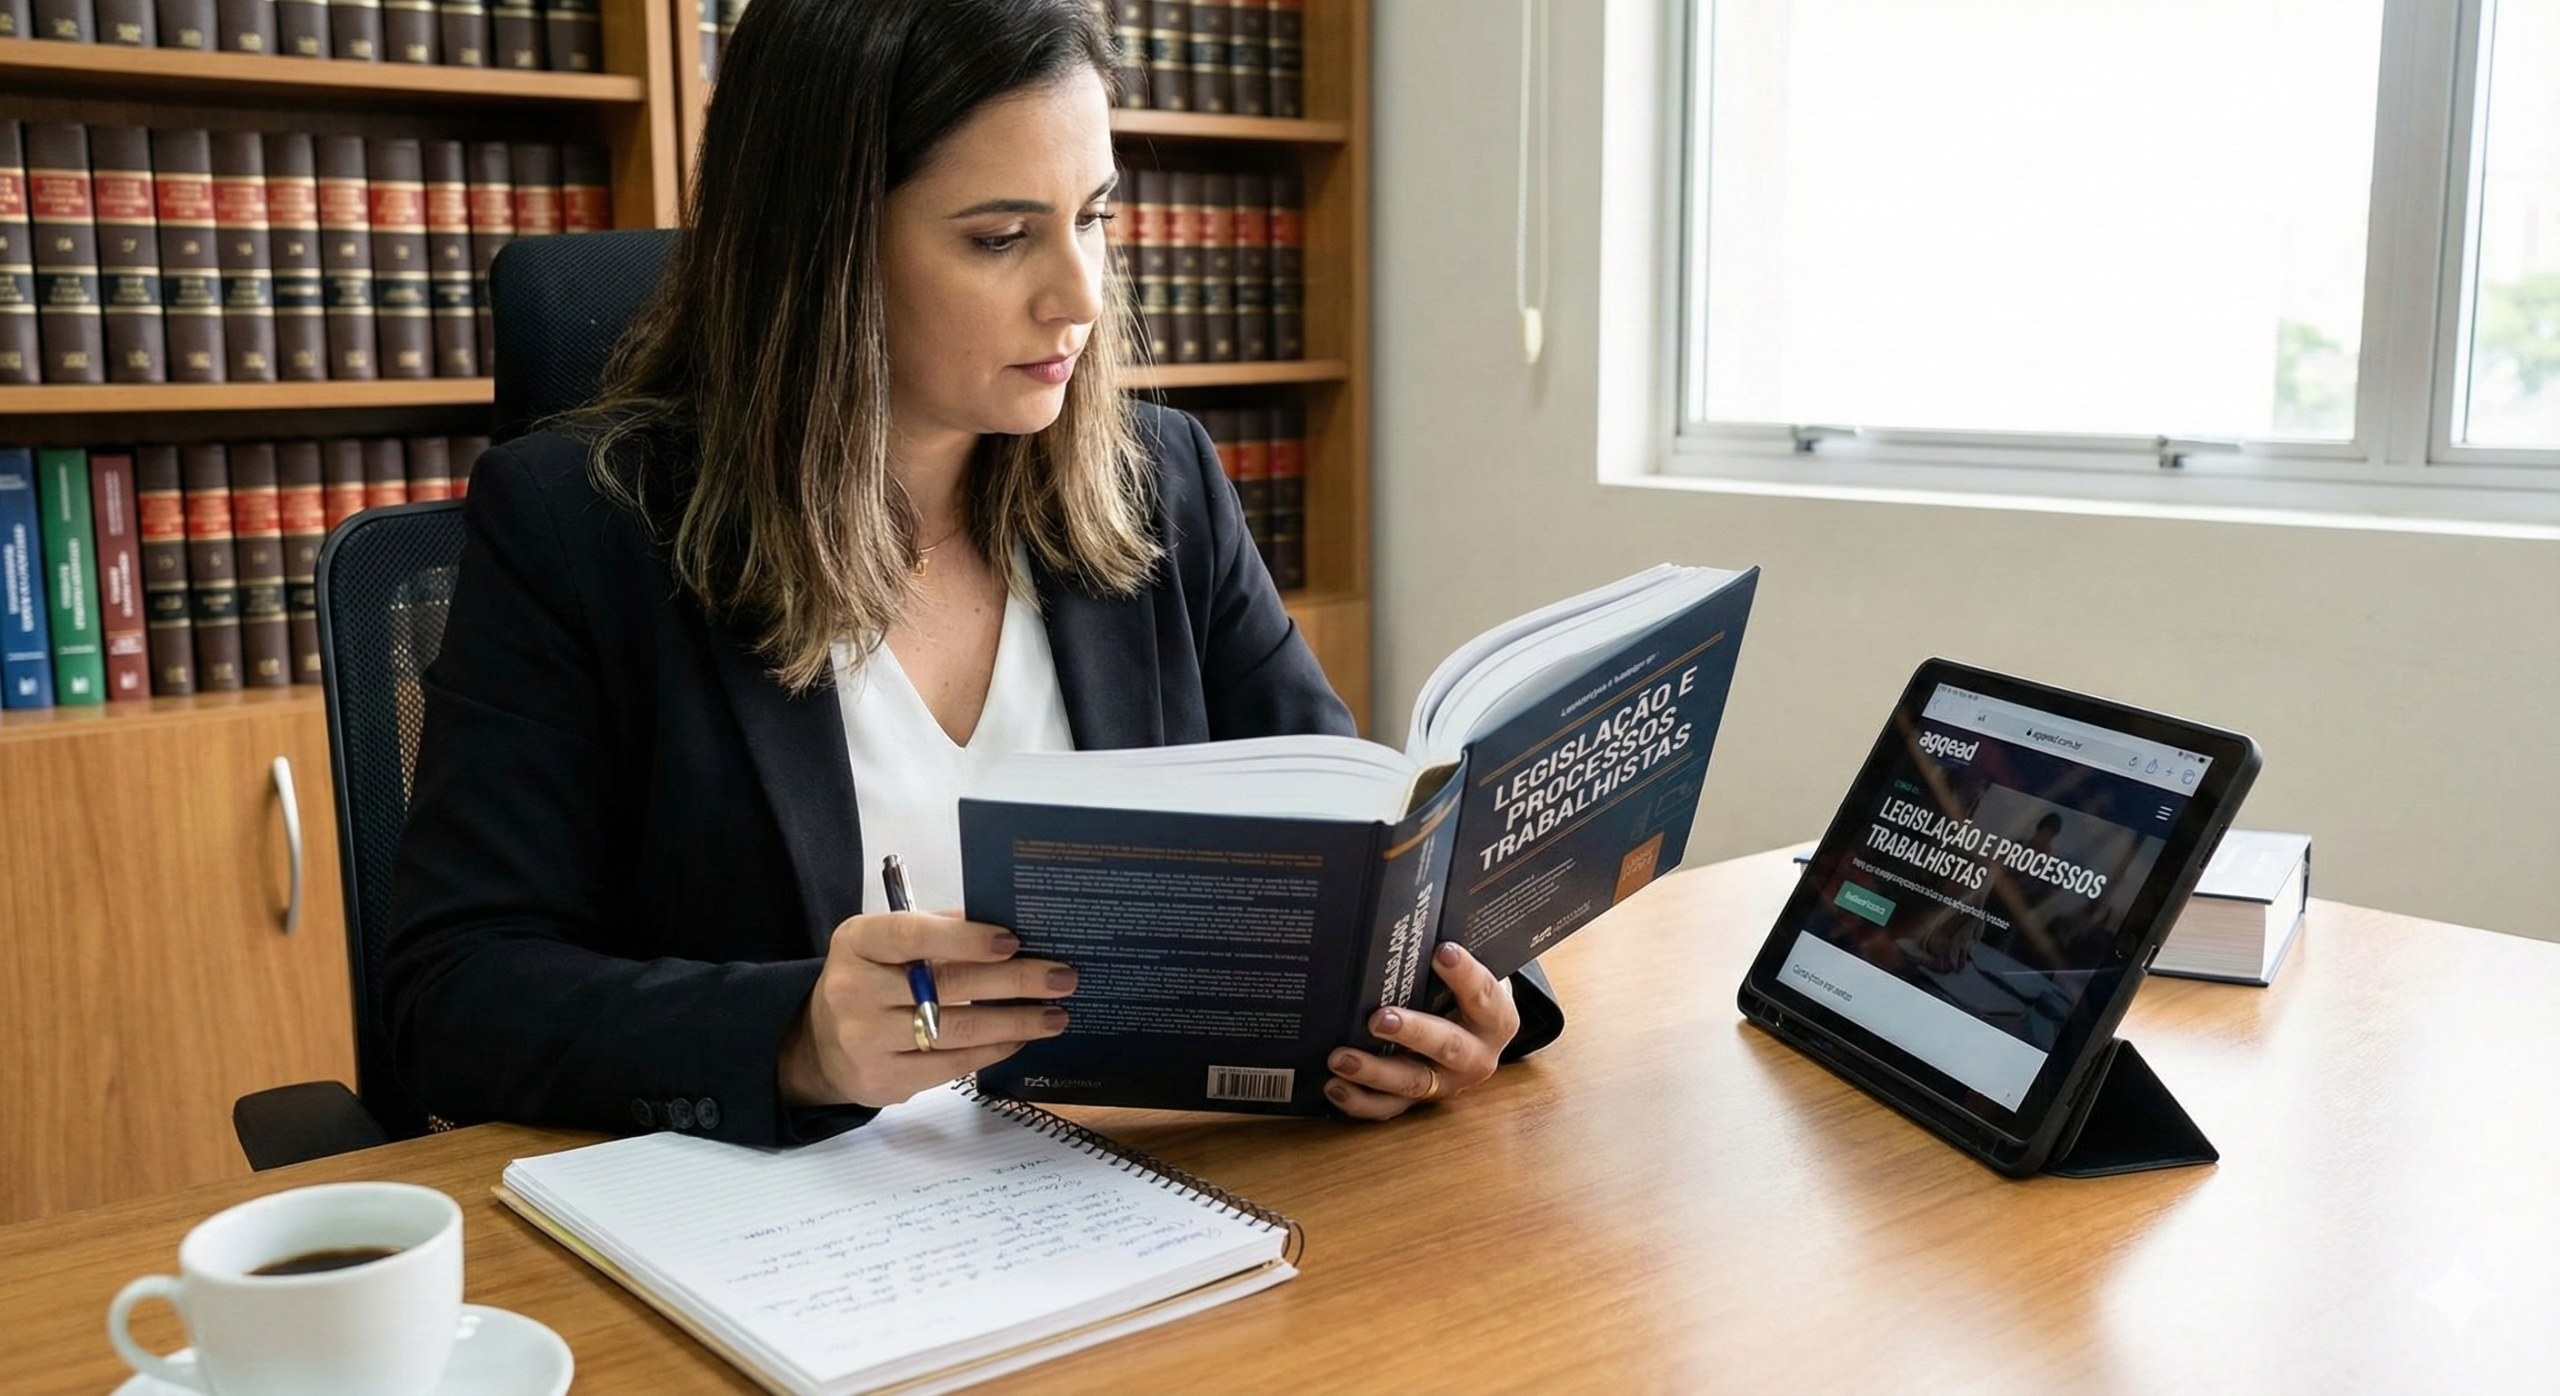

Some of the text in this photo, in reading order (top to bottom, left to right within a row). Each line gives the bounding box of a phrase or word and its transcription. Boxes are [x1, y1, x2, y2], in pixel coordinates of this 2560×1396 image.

[1480, 722, 1692, 871] TRABALHISTAS
[1494, 683, 1671, 812] LEGISLAÇÃO
[1678, 666, 1698, 697] E
[1506, 706, 1677, 831] PROCESSOS
[1865, 824, 1988, 890] TRABALHISTAS
[1879, 796, 1981, 851] LEGISLAÇÃO
[1978, 833, 1998, 857] E
[1992, 839, 2107, 899] PROCESSOS
